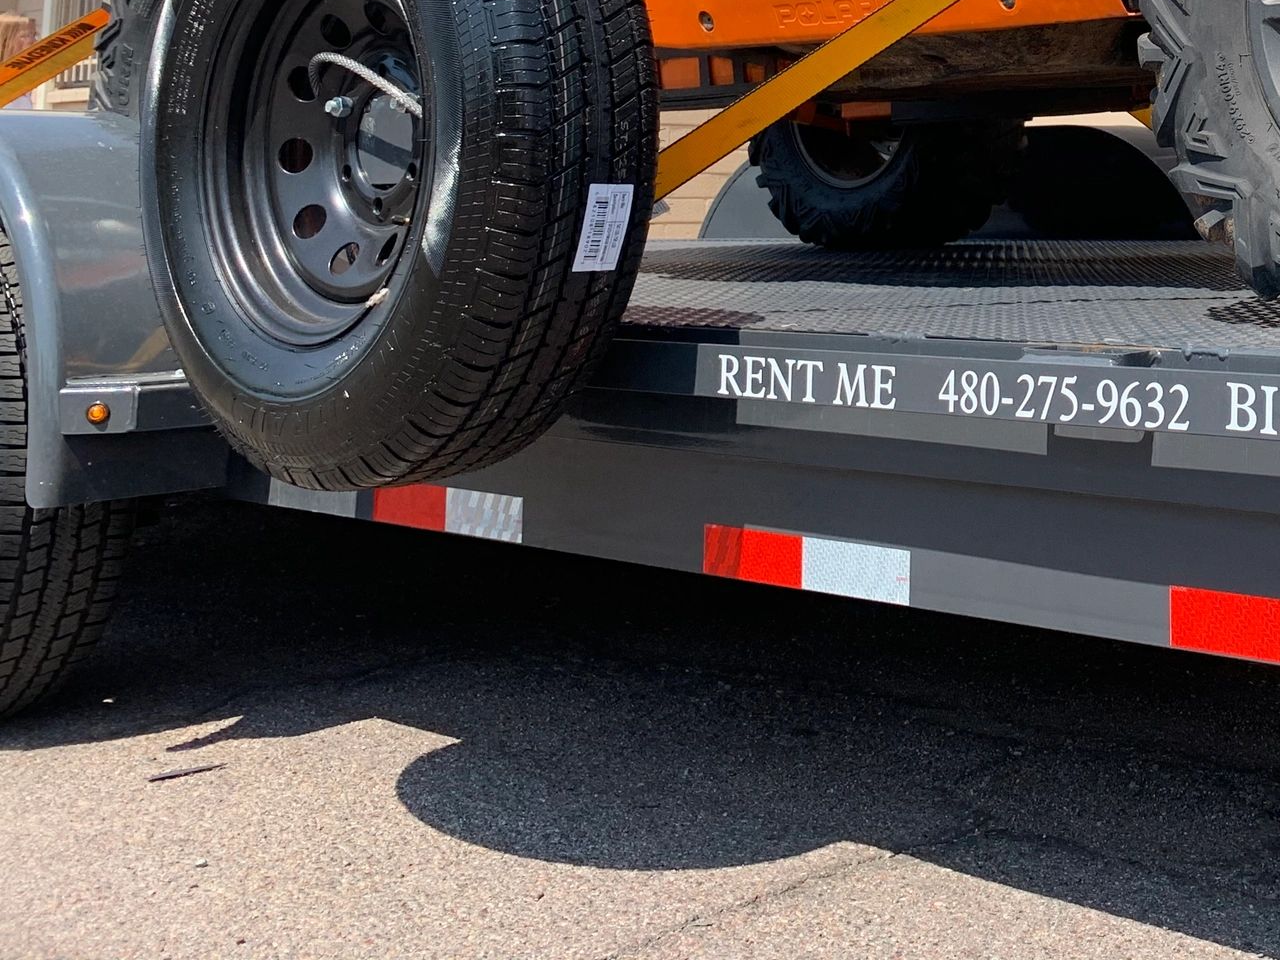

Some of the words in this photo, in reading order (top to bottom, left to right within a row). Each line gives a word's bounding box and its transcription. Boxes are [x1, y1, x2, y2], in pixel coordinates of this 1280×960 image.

[717, 354, 823, 403] RENT
[833, 363, 897, 410] ME
[938, 369, 1191, 431] 480-275-9632
